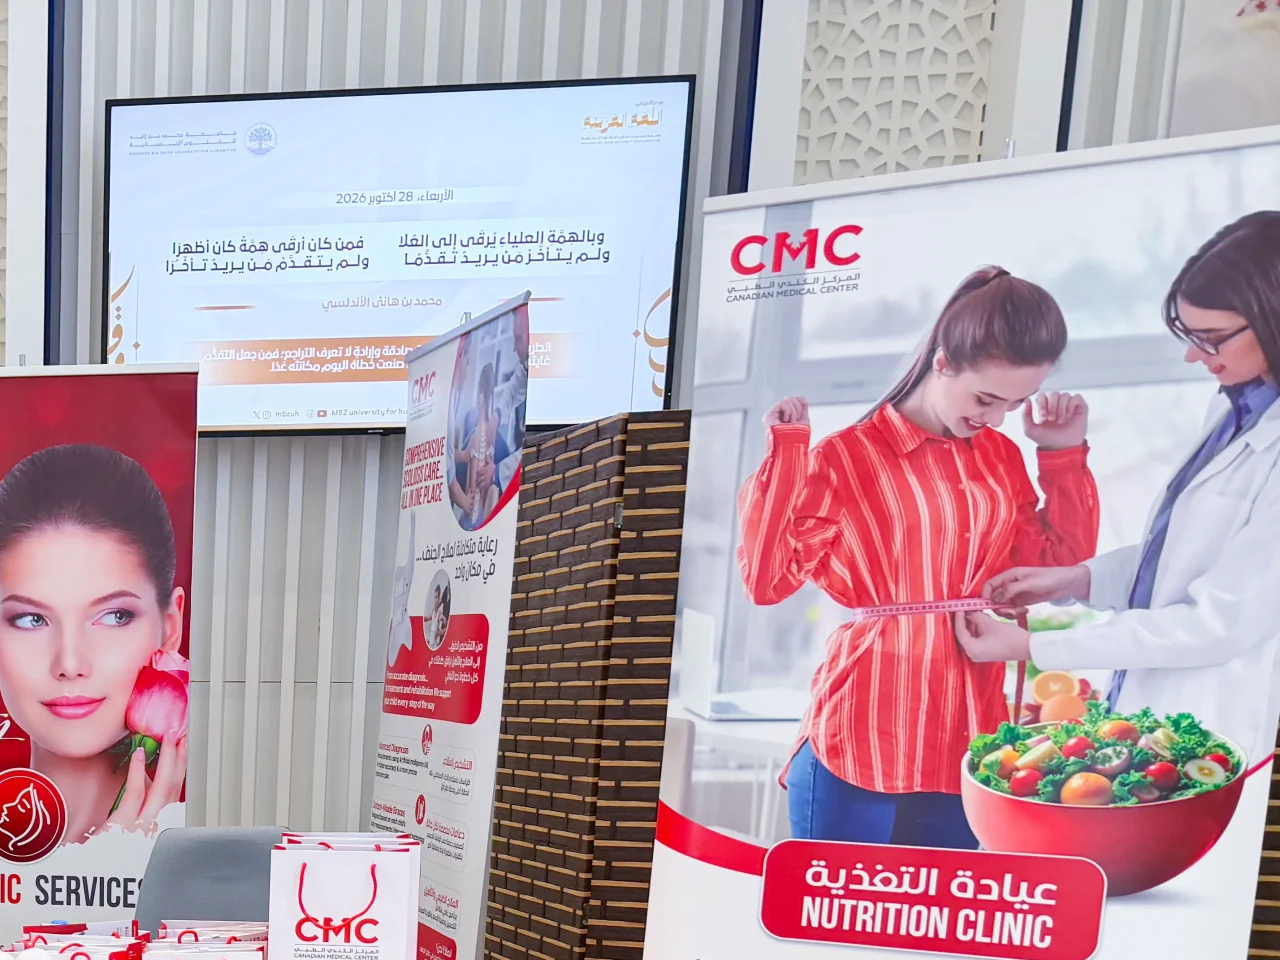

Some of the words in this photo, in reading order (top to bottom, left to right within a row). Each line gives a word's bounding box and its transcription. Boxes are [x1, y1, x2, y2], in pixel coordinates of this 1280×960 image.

[336, 193, 367, 204] 2026
[368, 191, 396, 205] أكتوبر
[398, 191, 413, 202] 28
[731, 224, 864, 275] CMC
[726, 292, 774, 302] CANADIAN
[776, 288, 817, 297] MEDICAL
[820, 284, 858, 293] CENTER
[412, 371, 436, 406] CMC
[349, 409, 385, 417] university
[405, 437, 445, 466] COMPREHENSIVE
[424, 483, 443, 505] PLACE
[805, 860, 939, 895] التغذية
[950, 870, 1057, 909] عيادة
[295, 917, 379, 944] CMC
[801, 897, 949, 939] NUTRITION
[956, 908, 1053, 948] CLINIC
